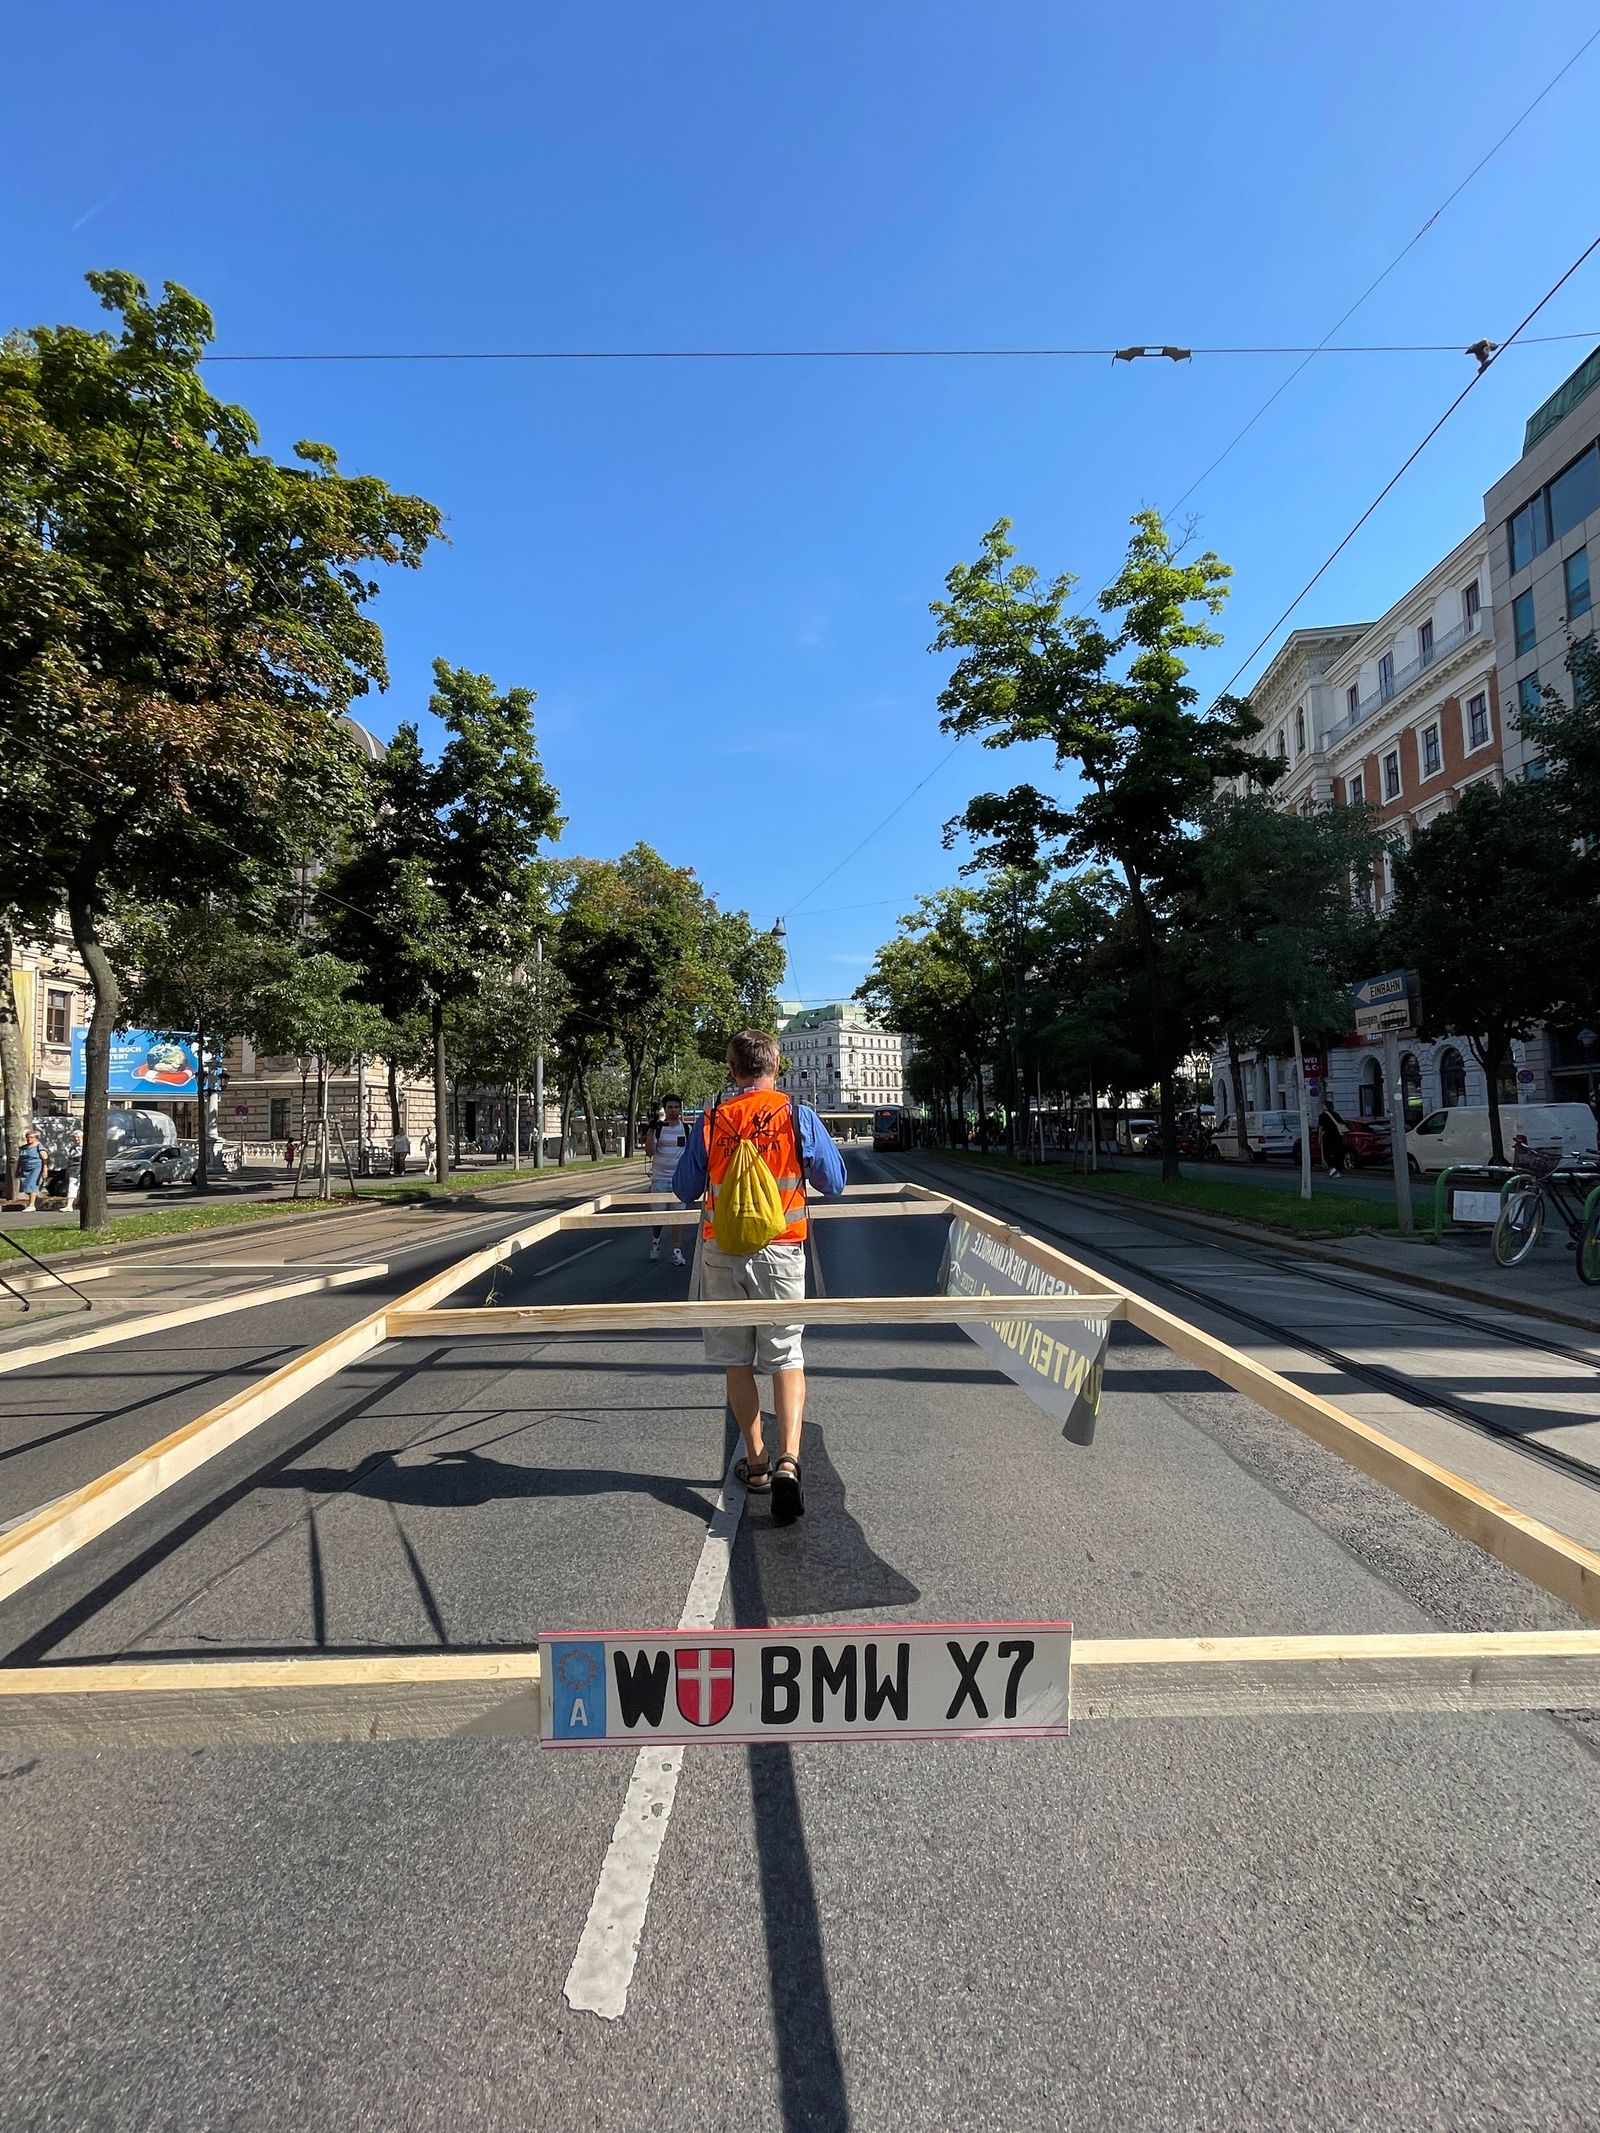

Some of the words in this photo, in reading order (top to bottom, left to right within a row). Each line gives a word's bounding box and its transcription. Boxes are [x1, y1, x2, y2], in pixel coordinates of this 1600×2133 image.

[1370, 979, 1400, 997] EINBAHN
[613, 1650, 670, 1728] W
[761, 1643, 910, 1724] BMW
[946, 1640, 1035, 1720] X7
[569, 1697, 588, 1727] A
